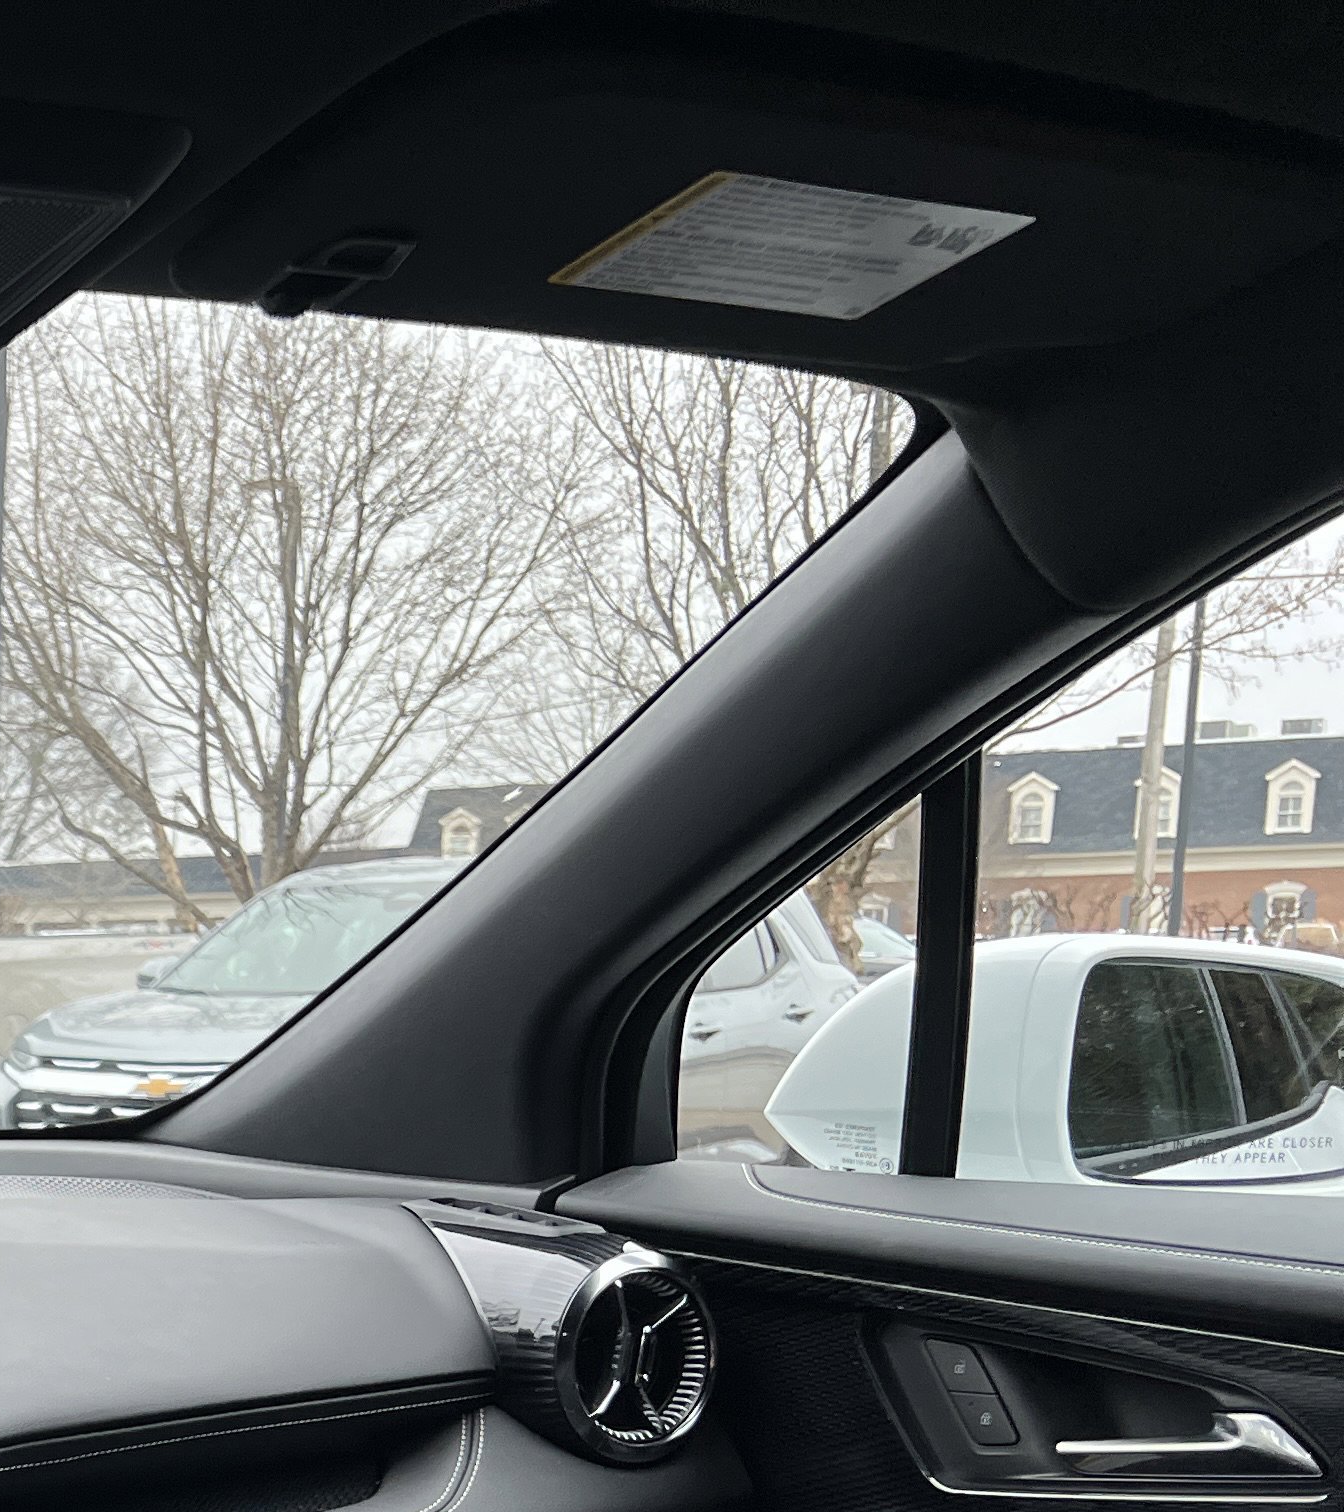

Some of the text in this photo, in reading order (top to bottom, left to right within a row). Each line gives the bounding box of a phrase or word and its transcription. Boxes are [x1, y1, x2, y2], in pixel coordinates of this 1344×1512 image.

[1249, 1138, 1274, 1149] ARE
[1282, 1136, 1334, 1149] CLOSER
[1235, 1152, 1286, 1164] APPEAR
